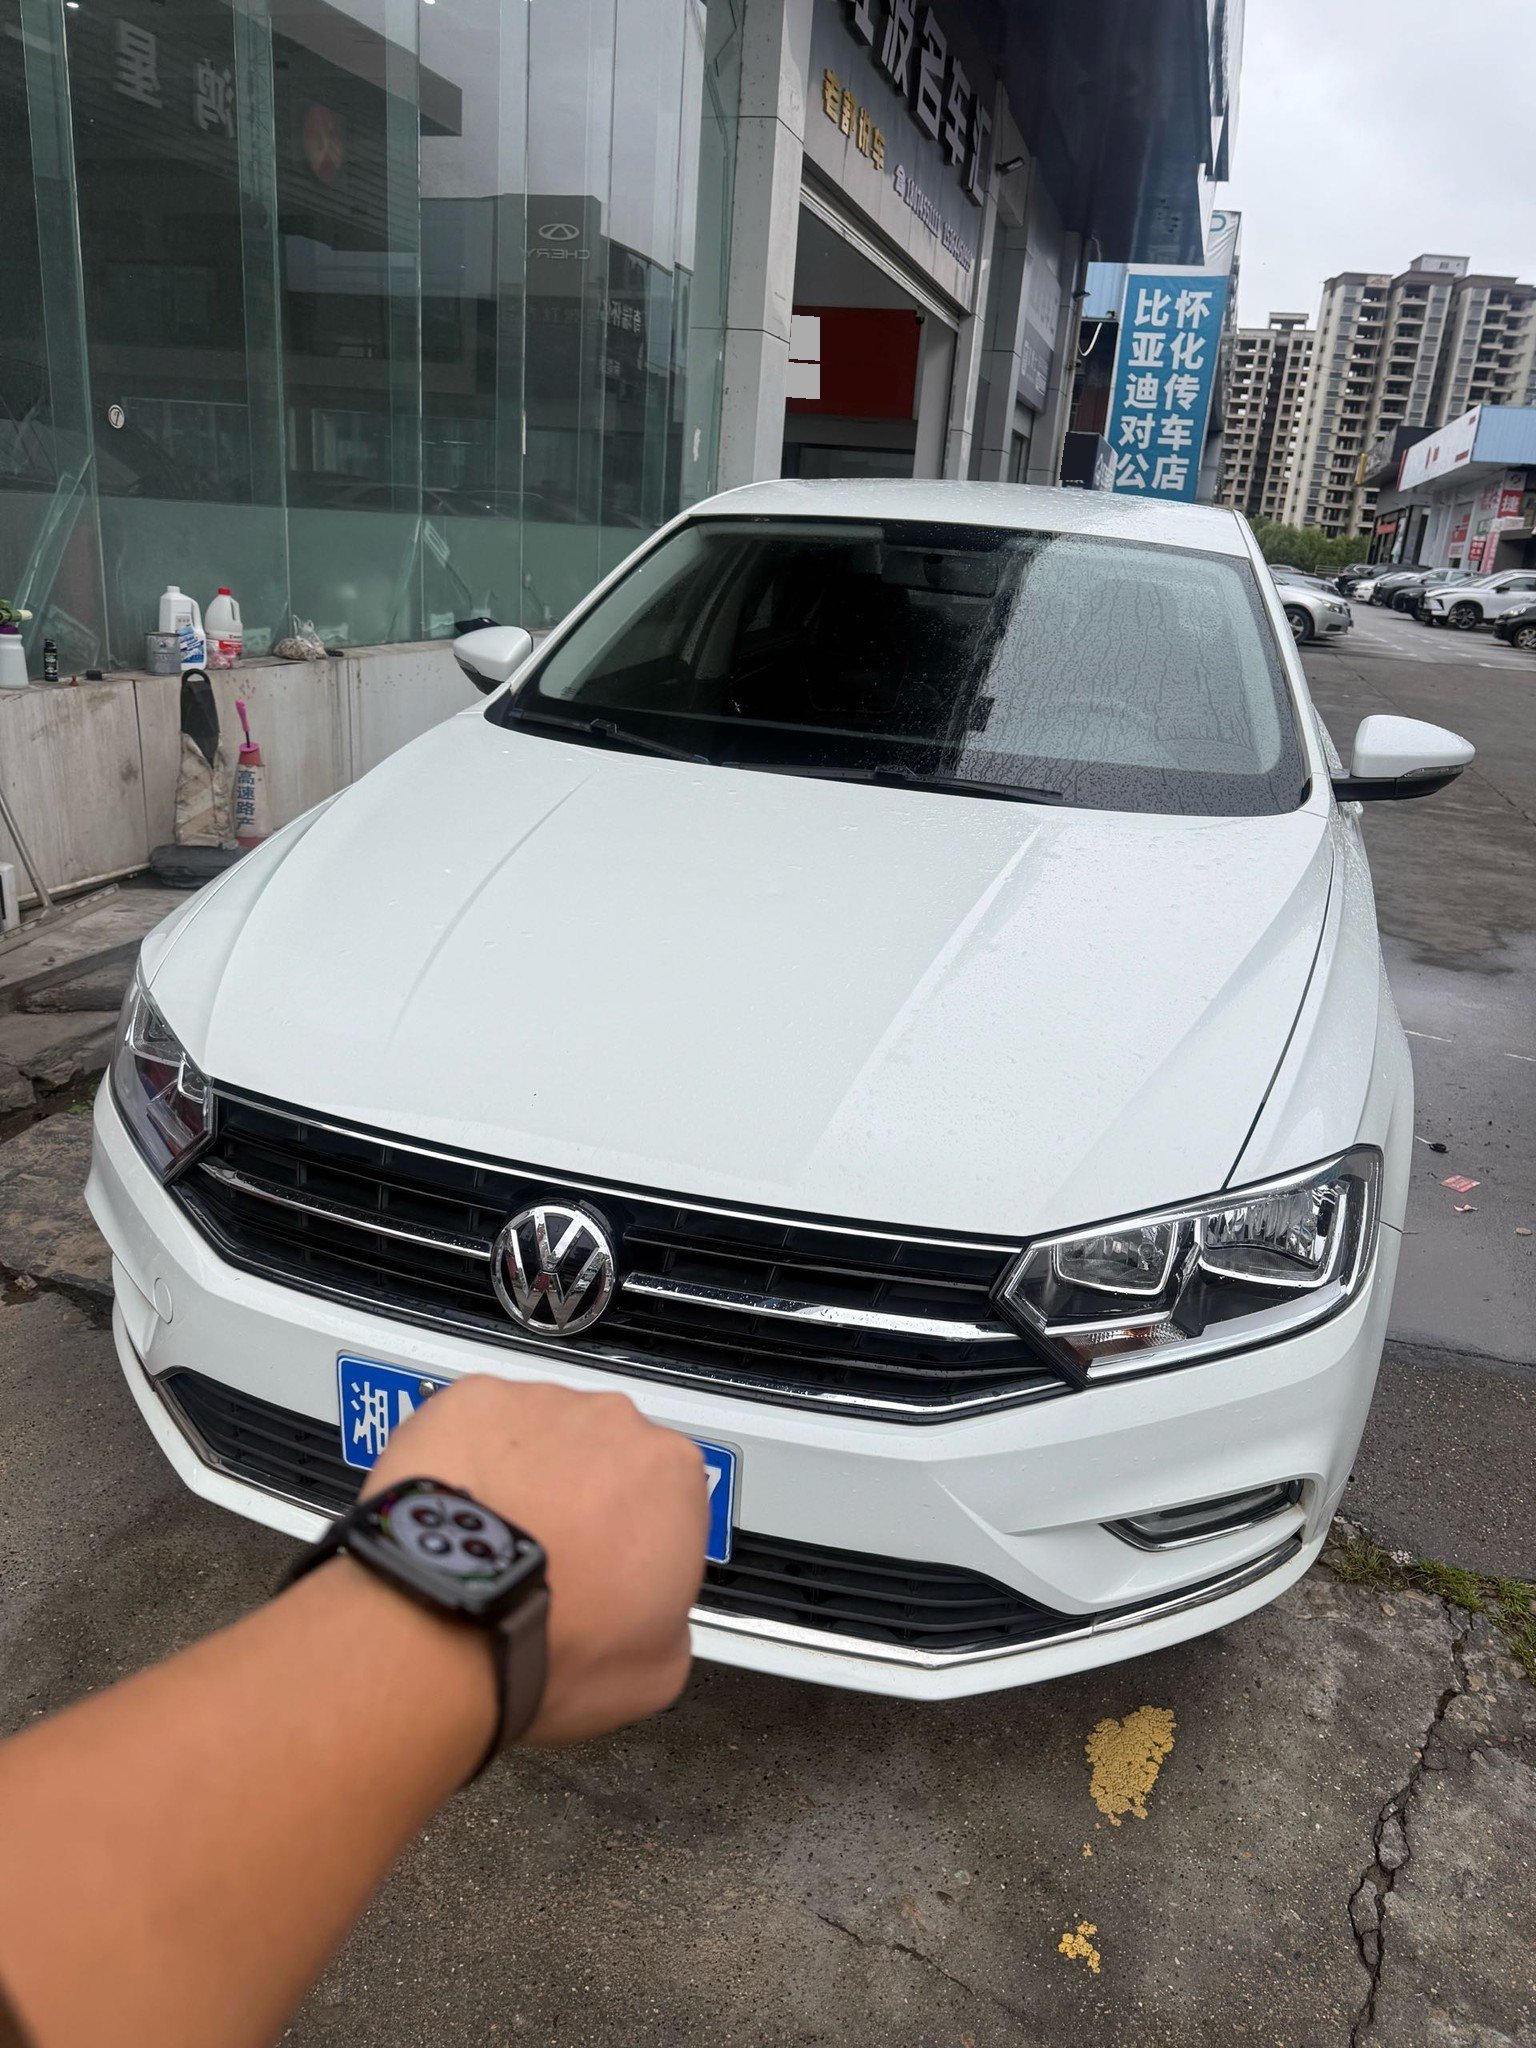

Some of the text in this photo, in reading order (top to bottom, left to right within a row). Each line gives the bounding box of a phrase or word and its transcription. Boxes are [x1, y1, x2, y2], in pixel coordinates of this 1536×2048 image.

[1115, 287, 1172, 490] 比亚迪对公
[1151, 288, 1213, 492] 怀化传车店
[236, 770, 256, 830] 高速路产
